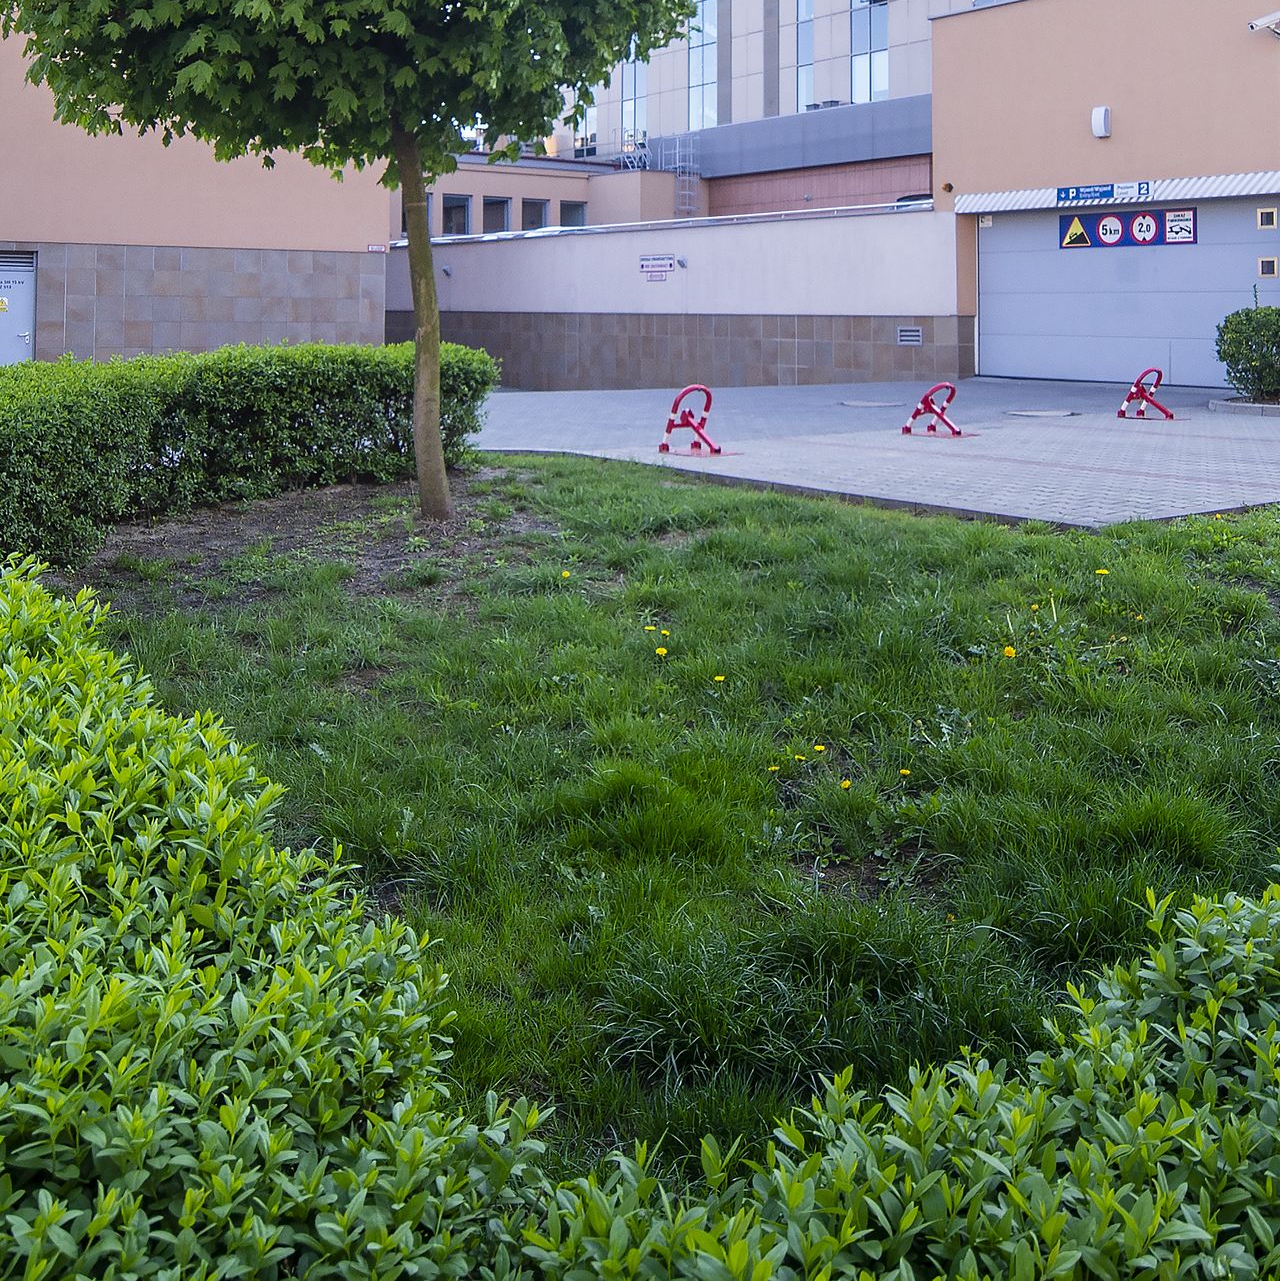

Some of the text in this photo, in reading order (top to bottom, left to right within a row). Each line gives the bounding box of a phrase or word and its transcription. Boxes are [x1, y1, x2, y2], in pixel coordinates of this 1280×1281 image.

[1139, 183, 1148, 194] 2
[1101, 224, 1108, 236] 5
[1137, 222, 1151, 234] 2,0
